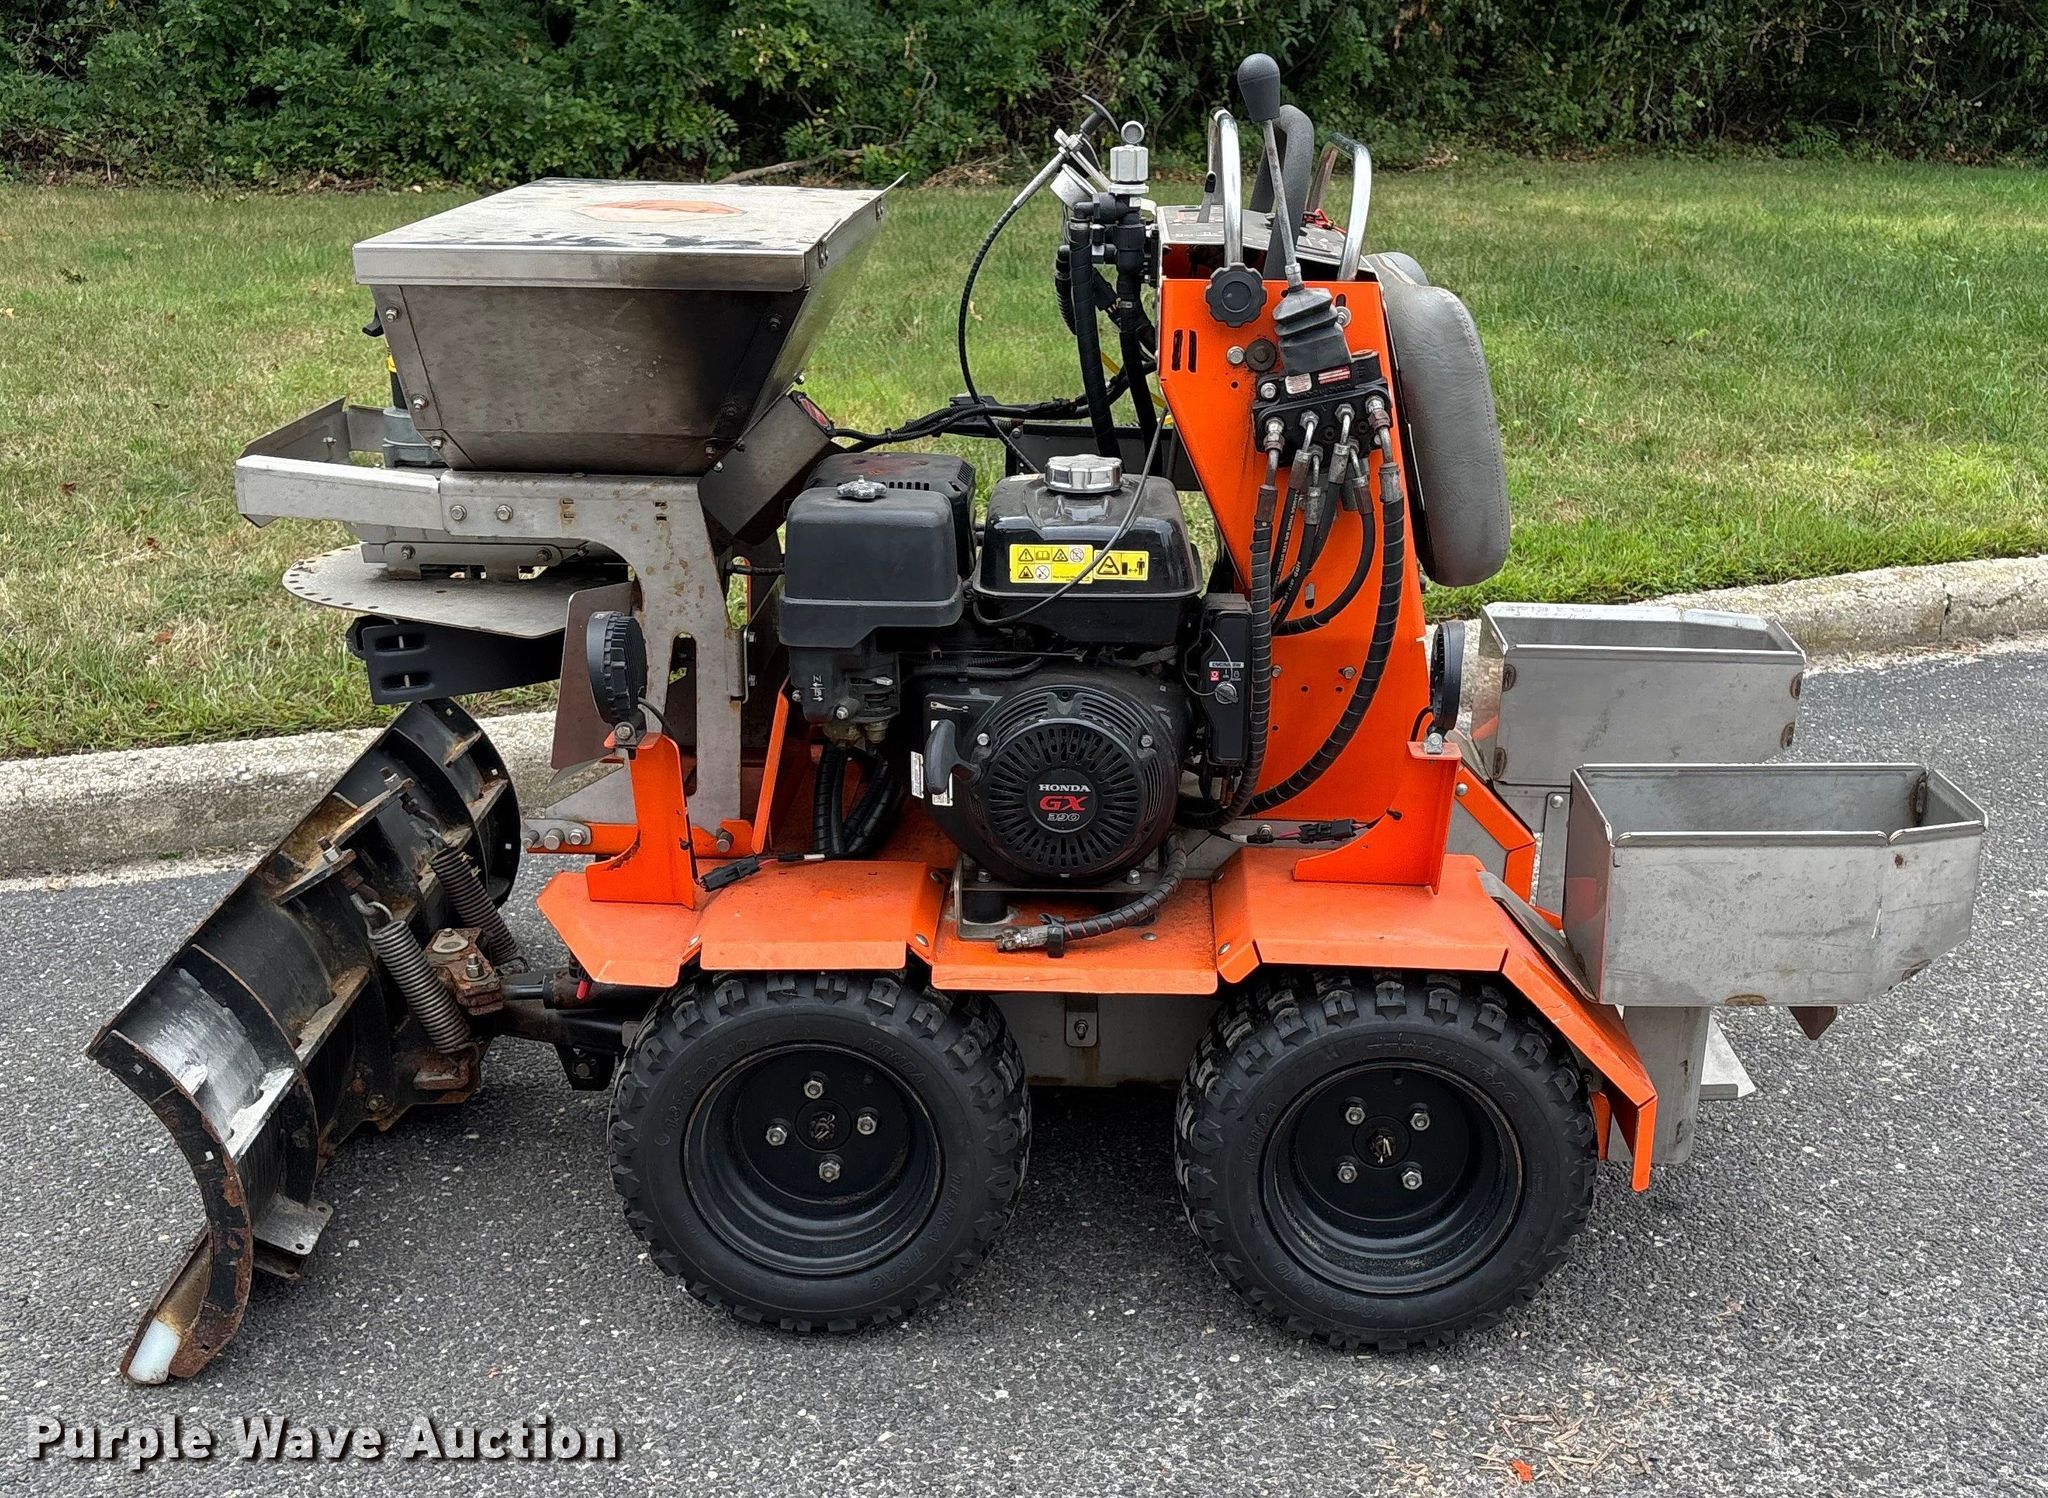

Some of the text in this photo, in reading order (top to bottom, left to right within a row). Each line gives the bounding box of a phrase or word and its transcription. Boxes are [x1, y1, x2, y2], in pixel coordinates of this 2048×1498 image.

[1039, 784, 1091, 792] HONDA
[1040, 795, 1088, 811] GX
[1047, 813, 1080, 821] 390
[865, 1038, 928, 1083] KENDA
[1240, 1103, 1279, 1167] KENDA
[870, 1247, 928, 1290] TRAC
